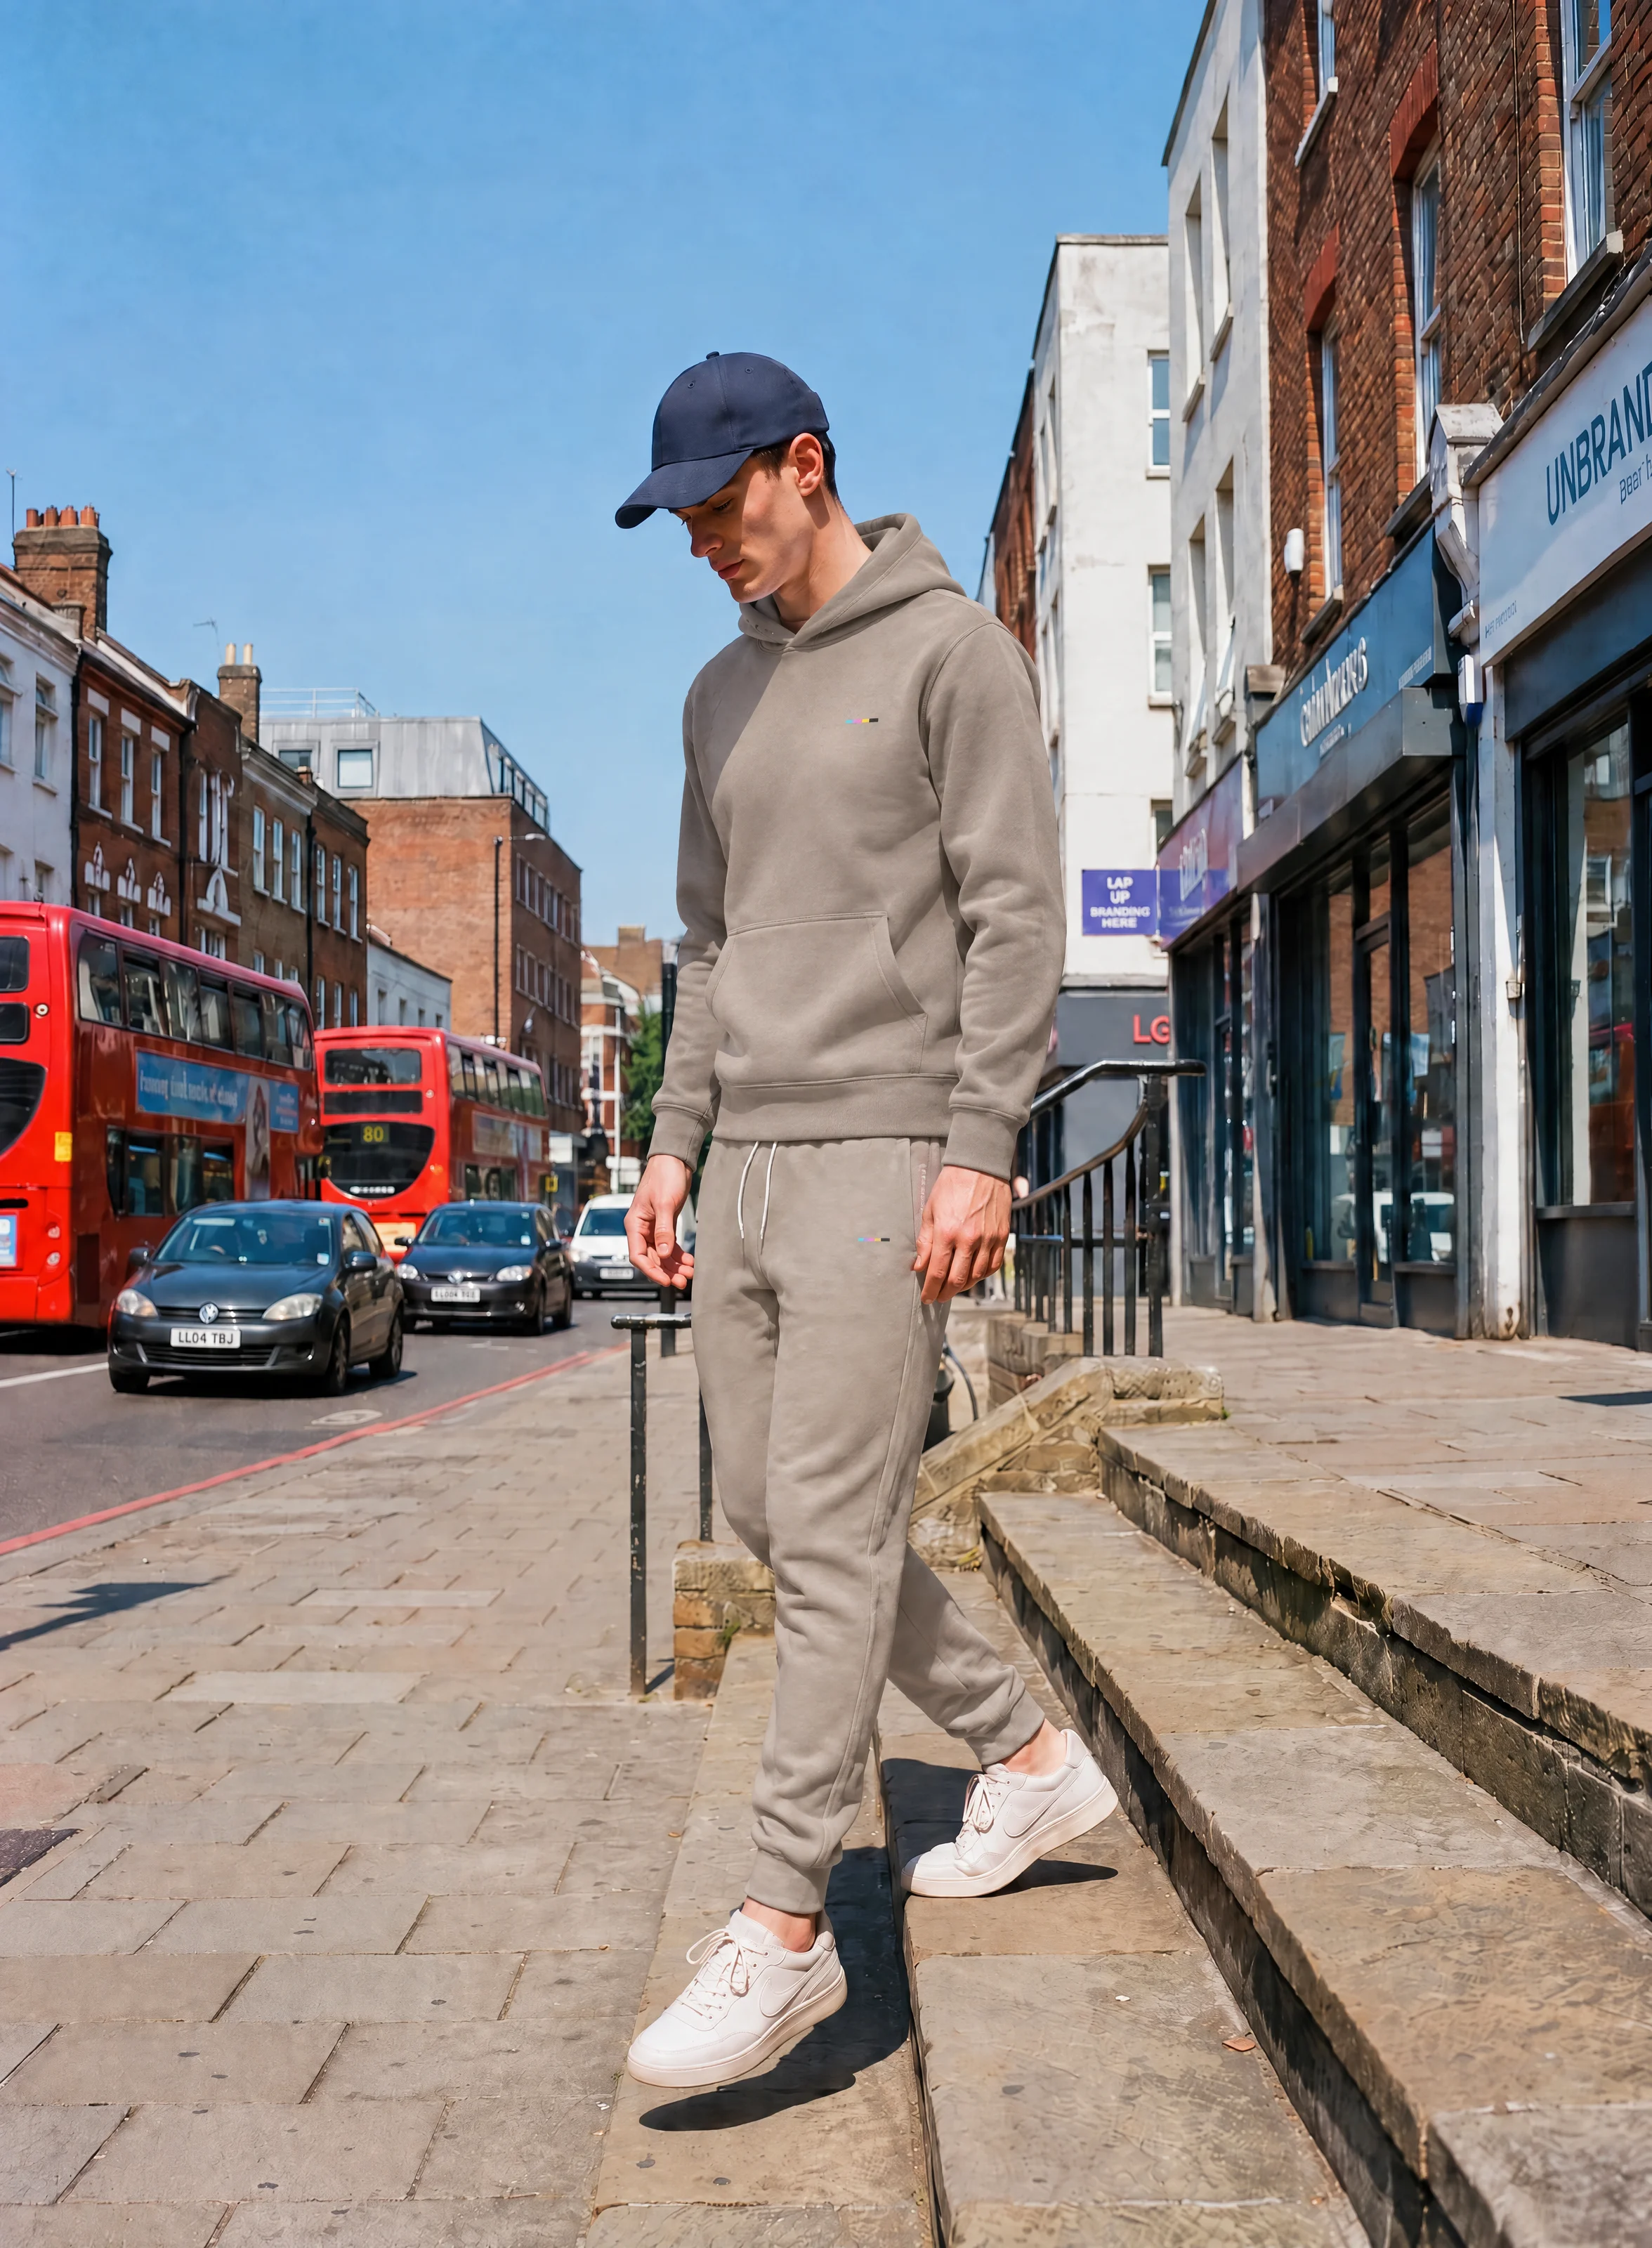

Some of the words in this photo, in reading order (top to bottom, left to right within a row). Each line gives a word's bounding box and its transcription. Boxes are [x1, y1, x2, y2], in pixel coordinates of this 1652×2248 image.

[1107, 876, 1134, 889] LAP
[1110, 889, 1131, 904] UP
[1089, 906, 1150, 917] BRANDING
[1101, 917, 1138, 928] HERE
[362, 1125, 383, 1142] 80
[211, 1333, 233, 1344] TBJ
